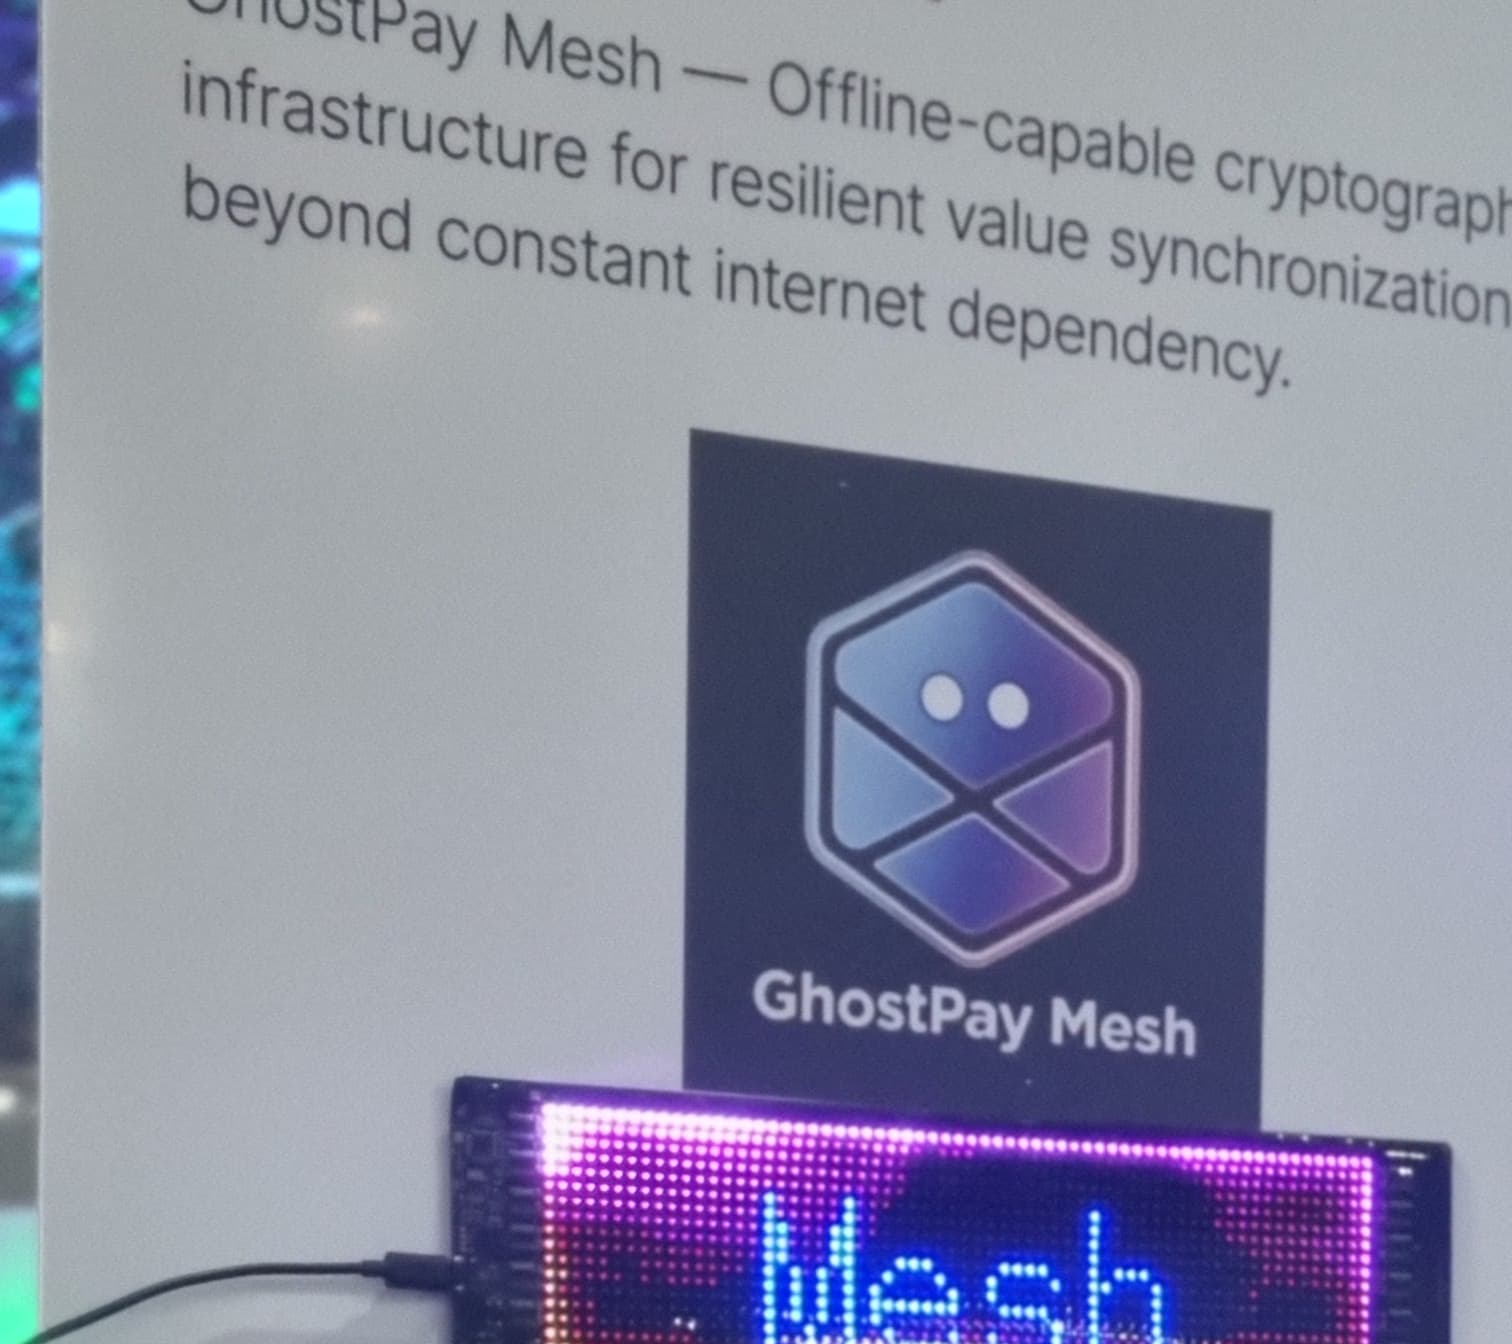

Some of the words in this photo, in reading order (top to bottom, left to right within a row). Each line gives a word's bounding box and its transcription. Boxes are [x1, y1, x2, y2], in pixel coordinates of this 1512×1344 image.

[182, 60, 588, 178] infrastructure
[610, 131, 689, 195] for
[710, 158, 926, 237] resilient
[947, 193, 1090, 261] value
[1110, 222, 1512, 329] synchronization
[187, 0, 477, 72] ostPay
[503, 13, 663, 93] Mesh
[769, 60, 1196, 184] Offline-capable
[184, 163, 412, 251] beyond
[437, 211, 693, 297] constant
[714, 247, 927, 333] internet
[948, 287, 1292, 397] dependency.
[752, 968, 1034, 1055] GhostPay
[1050, 997, 1198, 1057] Mesh
